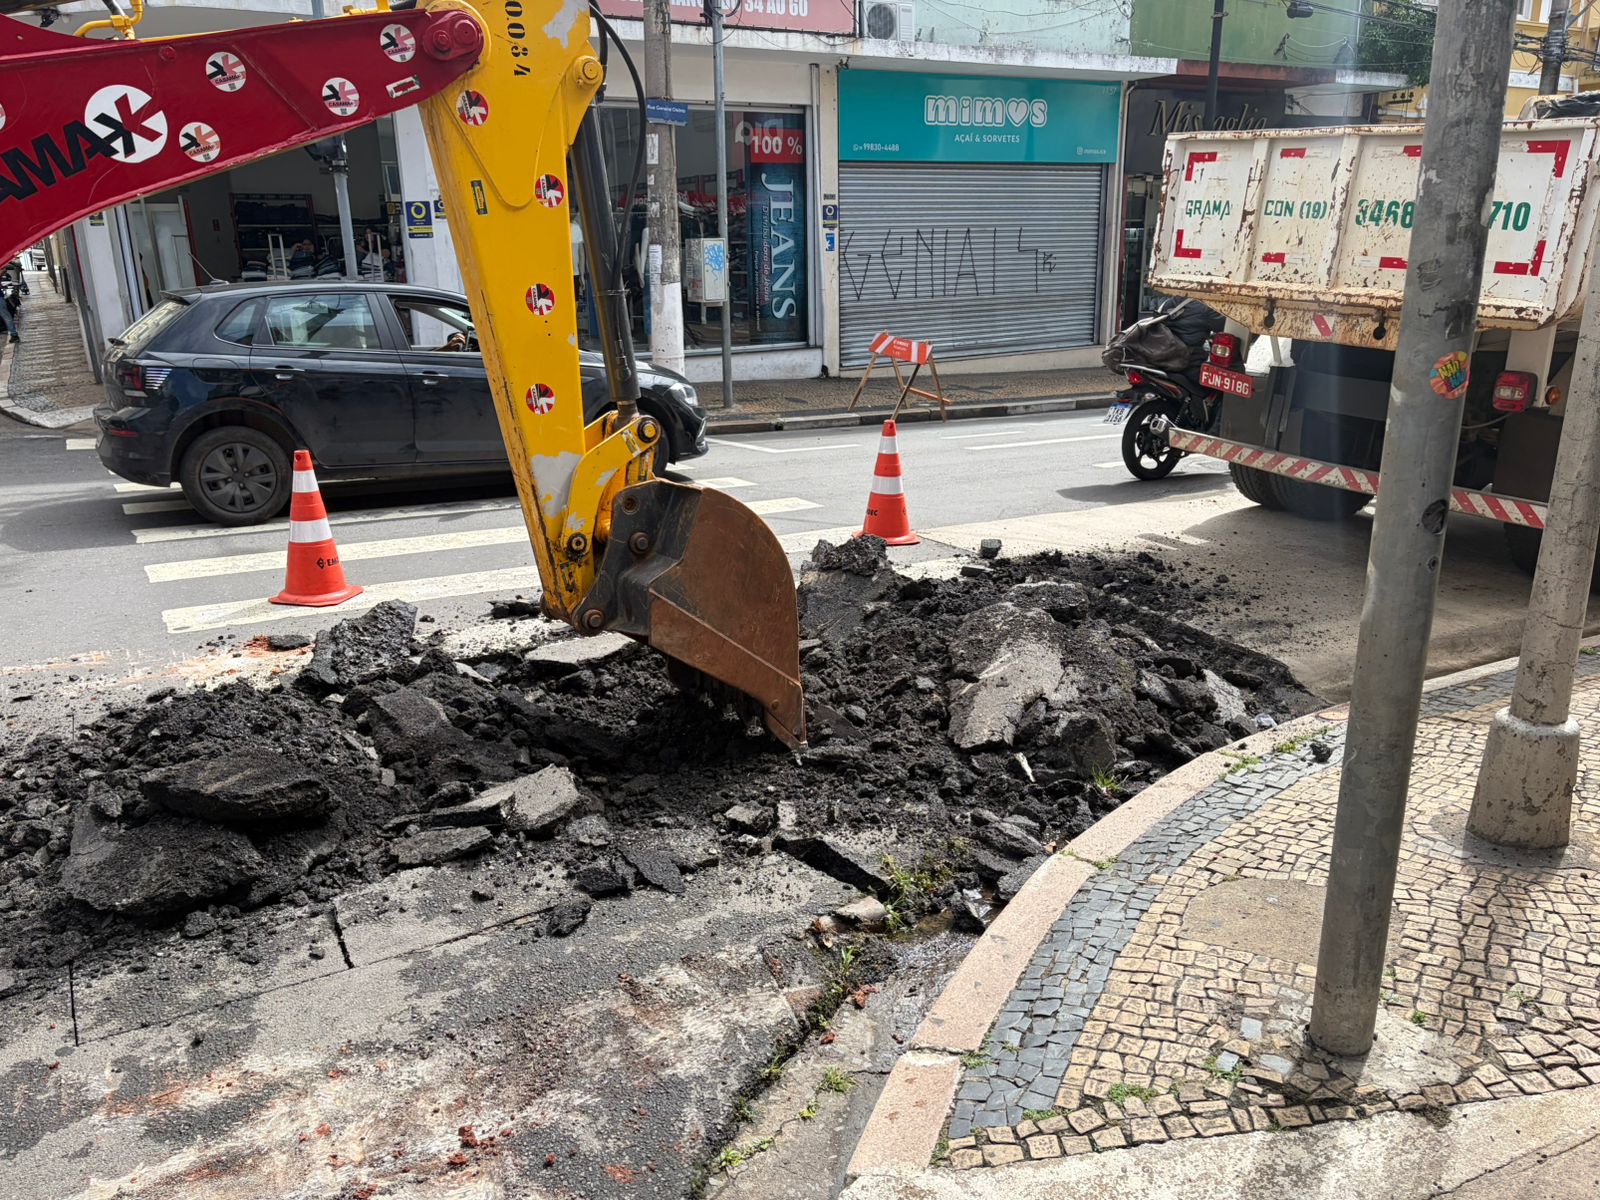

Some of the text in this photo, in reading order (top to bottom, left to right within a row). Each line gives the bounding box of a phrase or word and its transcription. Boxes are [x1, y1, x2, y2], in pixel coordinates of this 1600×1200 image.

[752, 135, 803, 156] 100 %
[954, 132, 1020, 143] AÇAÍ & SORVETES
[1185, 200, 1231, 220] GRAMA
[1264, 199, 1295, 217] CON
[760, 173, 797, 319] JEANS
